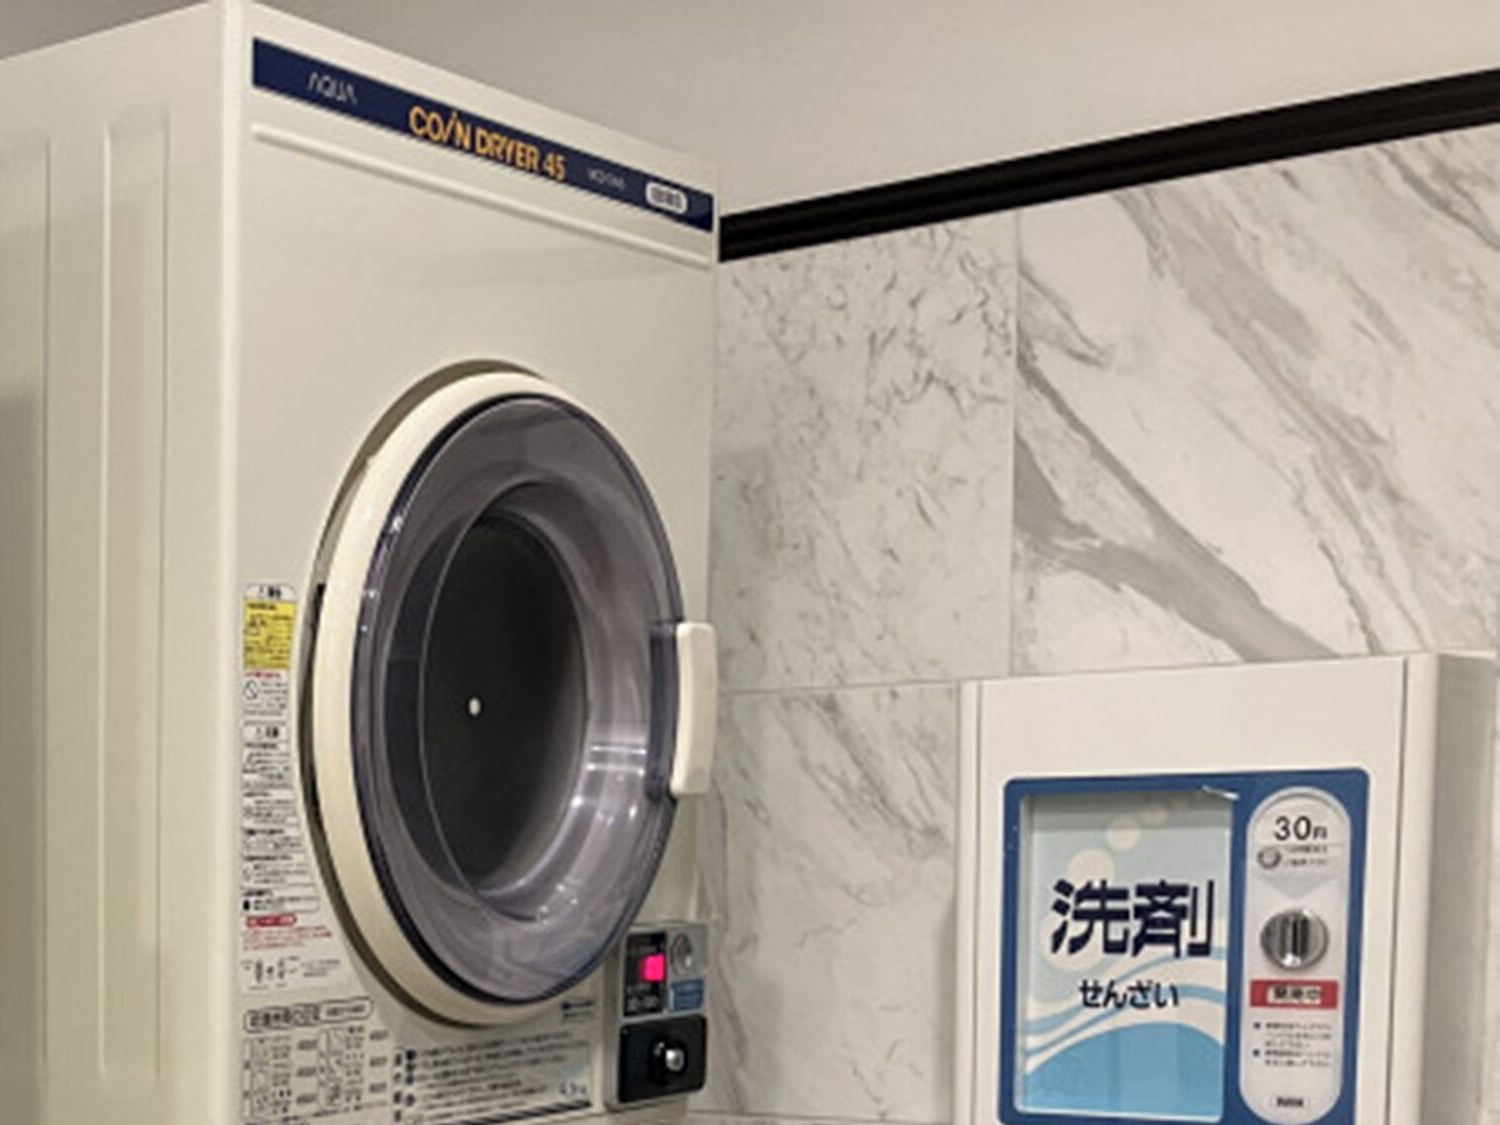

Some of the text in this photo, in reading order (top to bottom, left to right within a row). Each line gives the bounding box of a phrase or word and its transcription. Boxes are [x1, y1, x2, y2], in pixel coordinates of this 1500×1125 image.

[307, 71, 358, 105] AQUA
[475, 128, 541, 174] DRYER
[544, 151, 567, 182] 45
[1051, 879, 1215, 958] 洗剤
[1079, 979, 1179, 1008] せんざい
